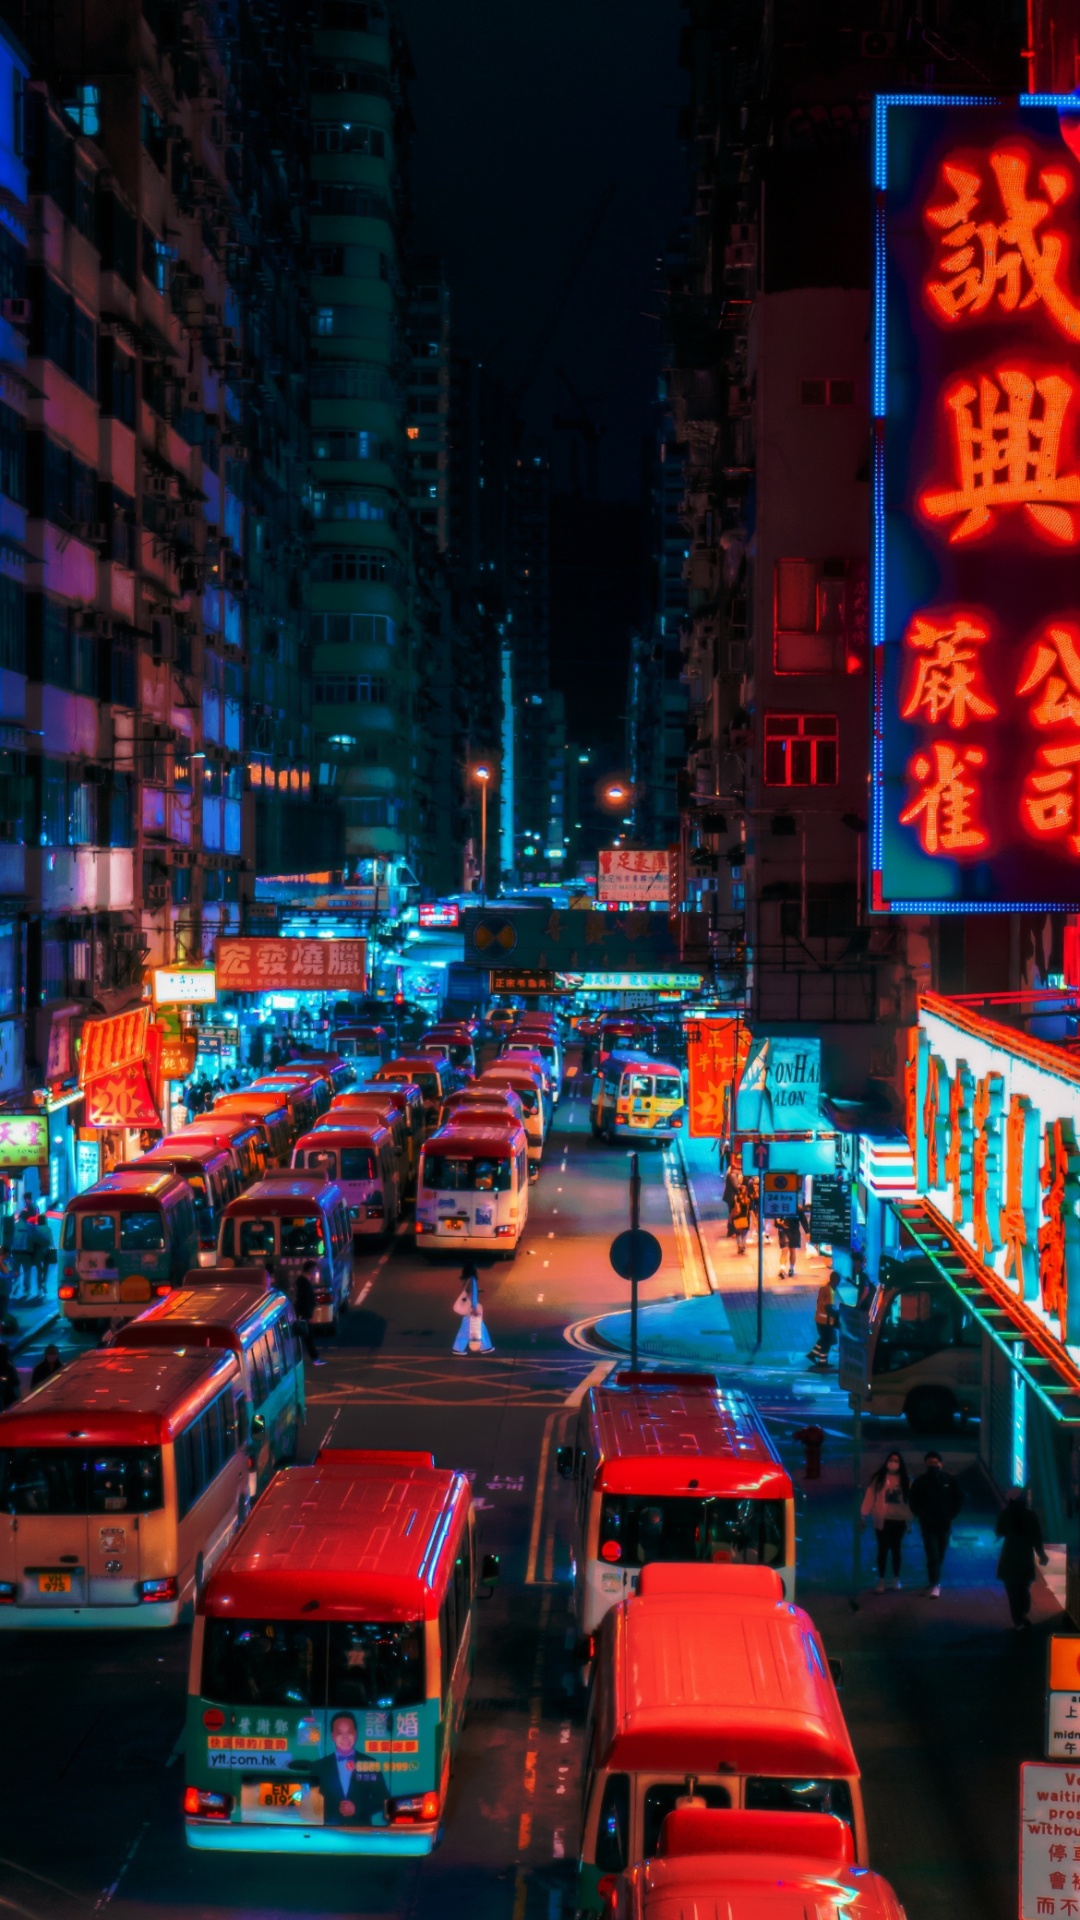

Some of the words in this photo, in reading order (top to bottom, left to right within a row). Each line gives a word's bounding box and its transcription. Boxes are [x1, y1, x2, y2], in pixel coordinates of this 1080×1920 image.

[767, 1193, 779, 1201] 24
[44, 1582, 65, 1591] 975
[272, 1784, 289, 1795] EN
